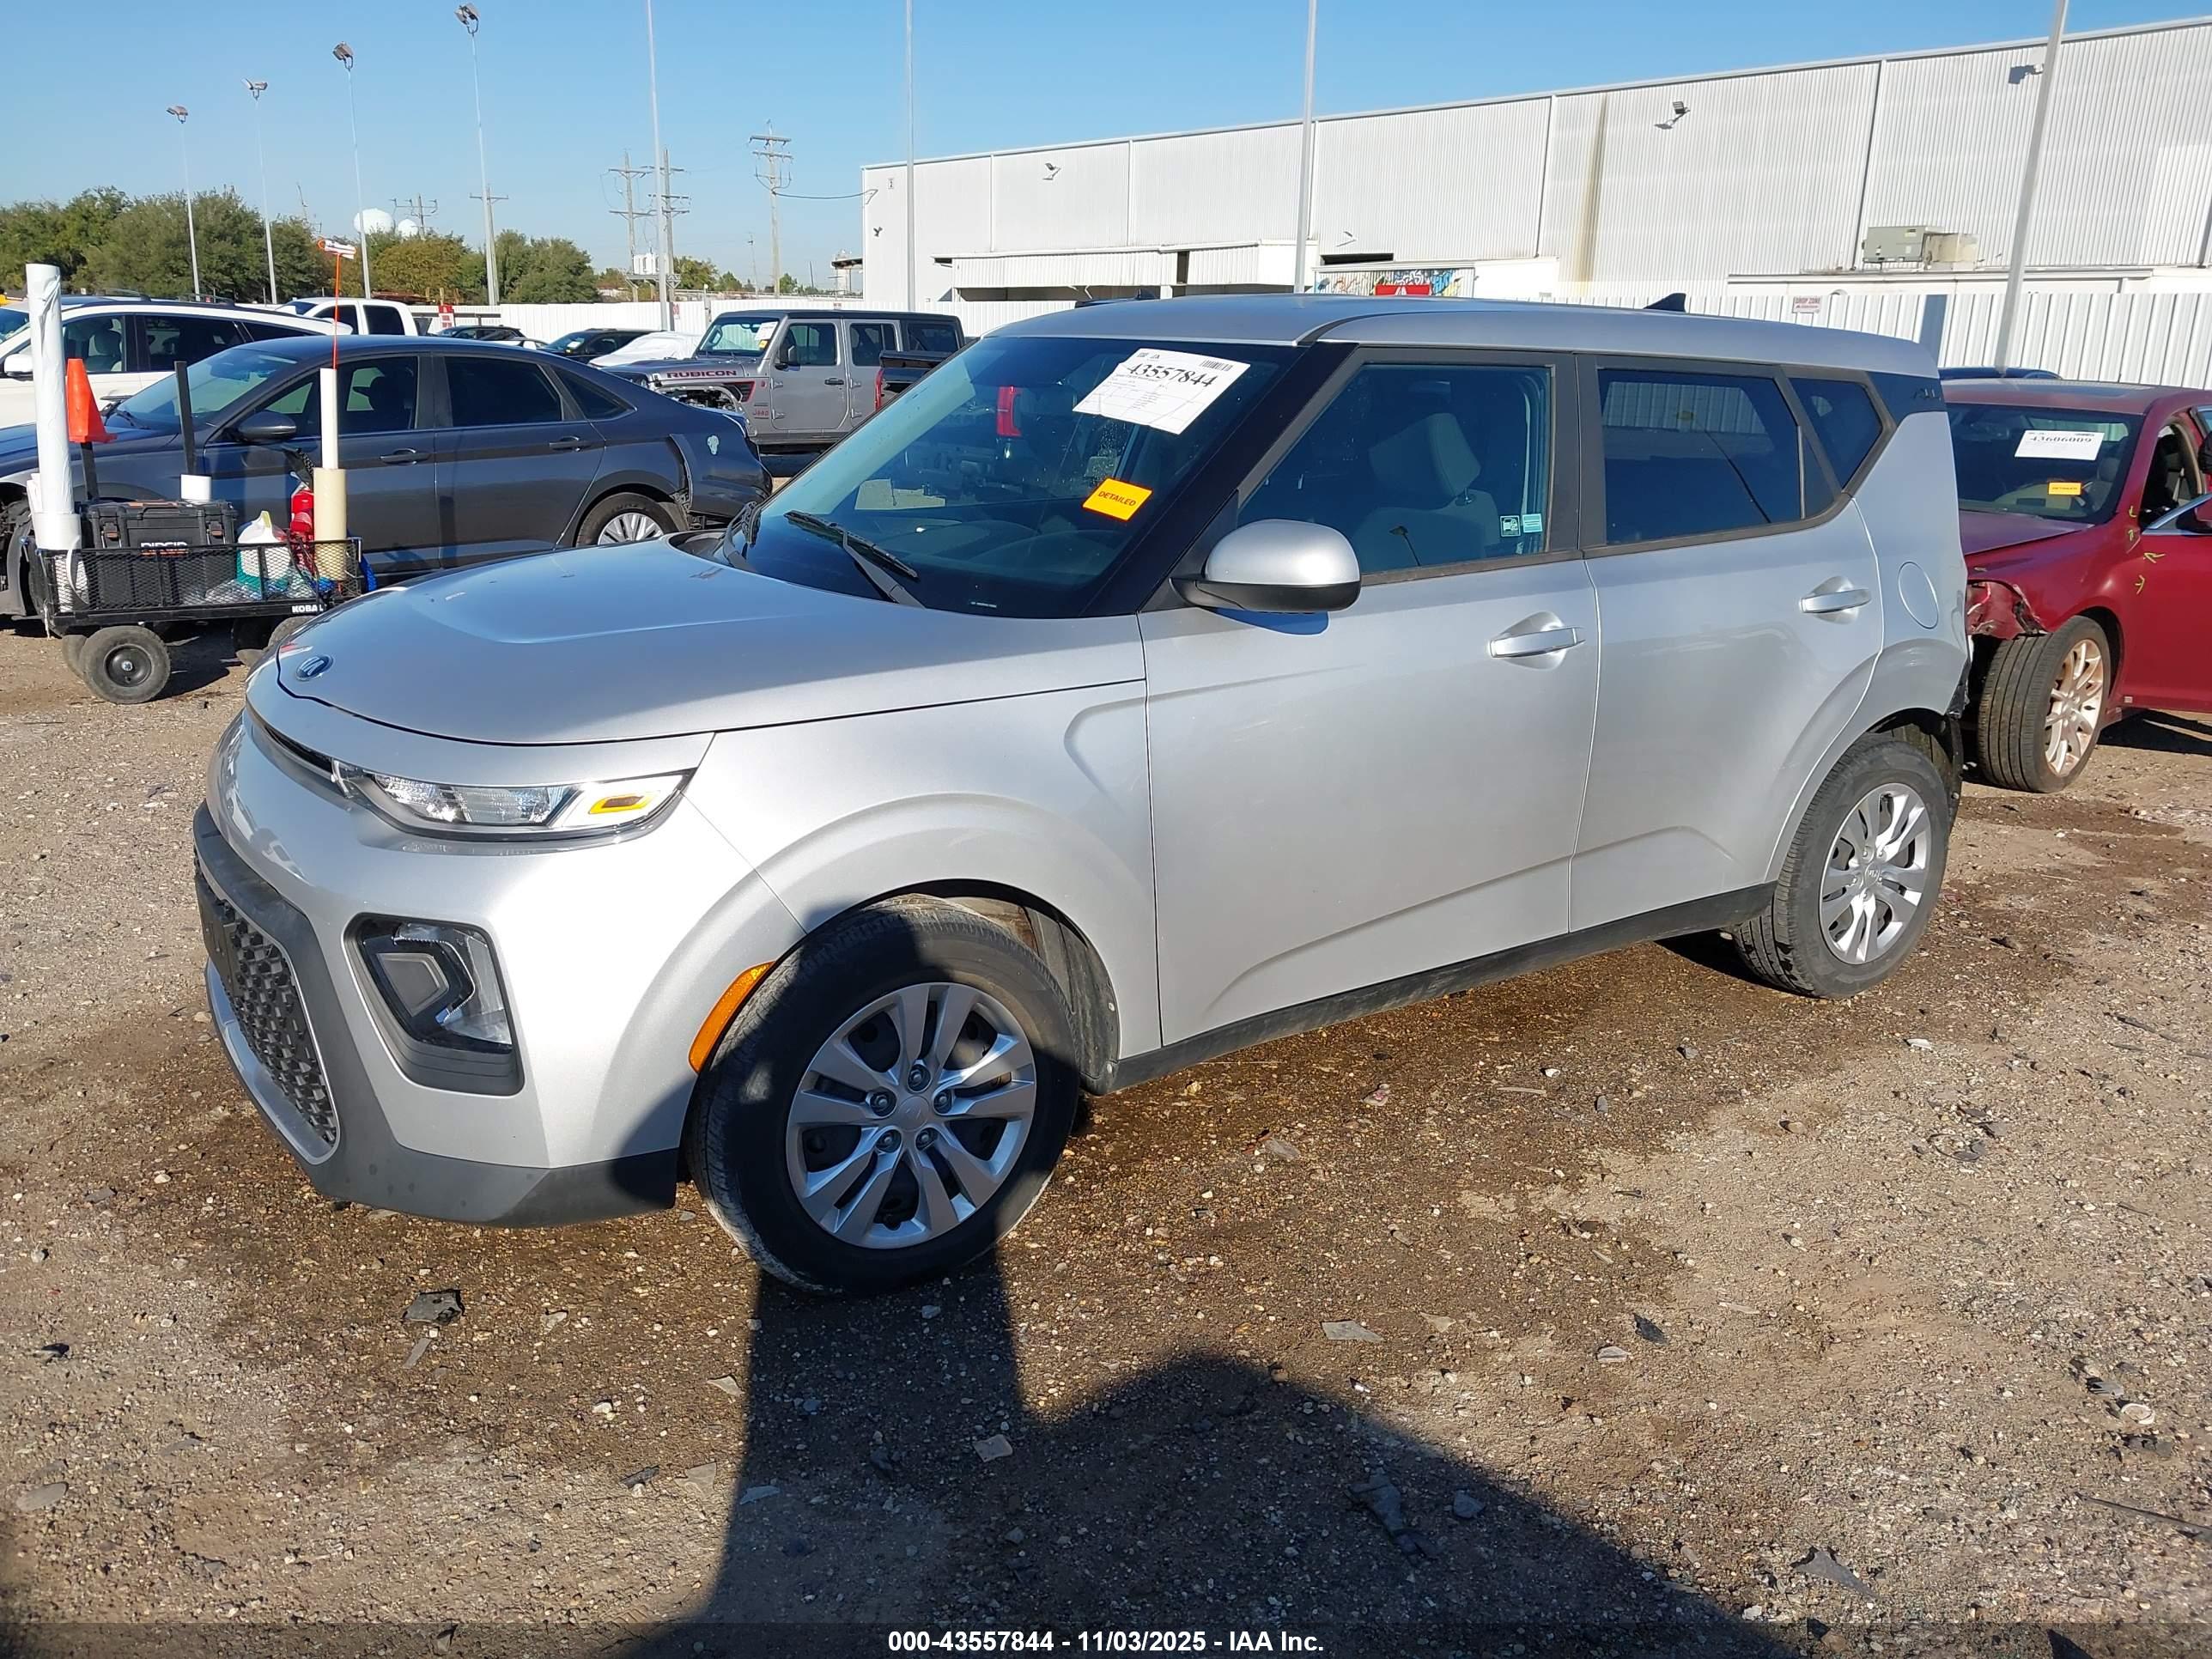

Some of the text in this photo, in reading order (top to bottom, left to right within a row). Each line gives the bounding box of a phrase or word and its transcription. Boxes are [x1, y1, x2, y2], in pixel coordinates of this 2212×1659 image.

[1127, 363, 1218, 387] 43557844
[1097, 491, 1136, 506] DETAILED
[292, 604, 327, 613] KOBAL
